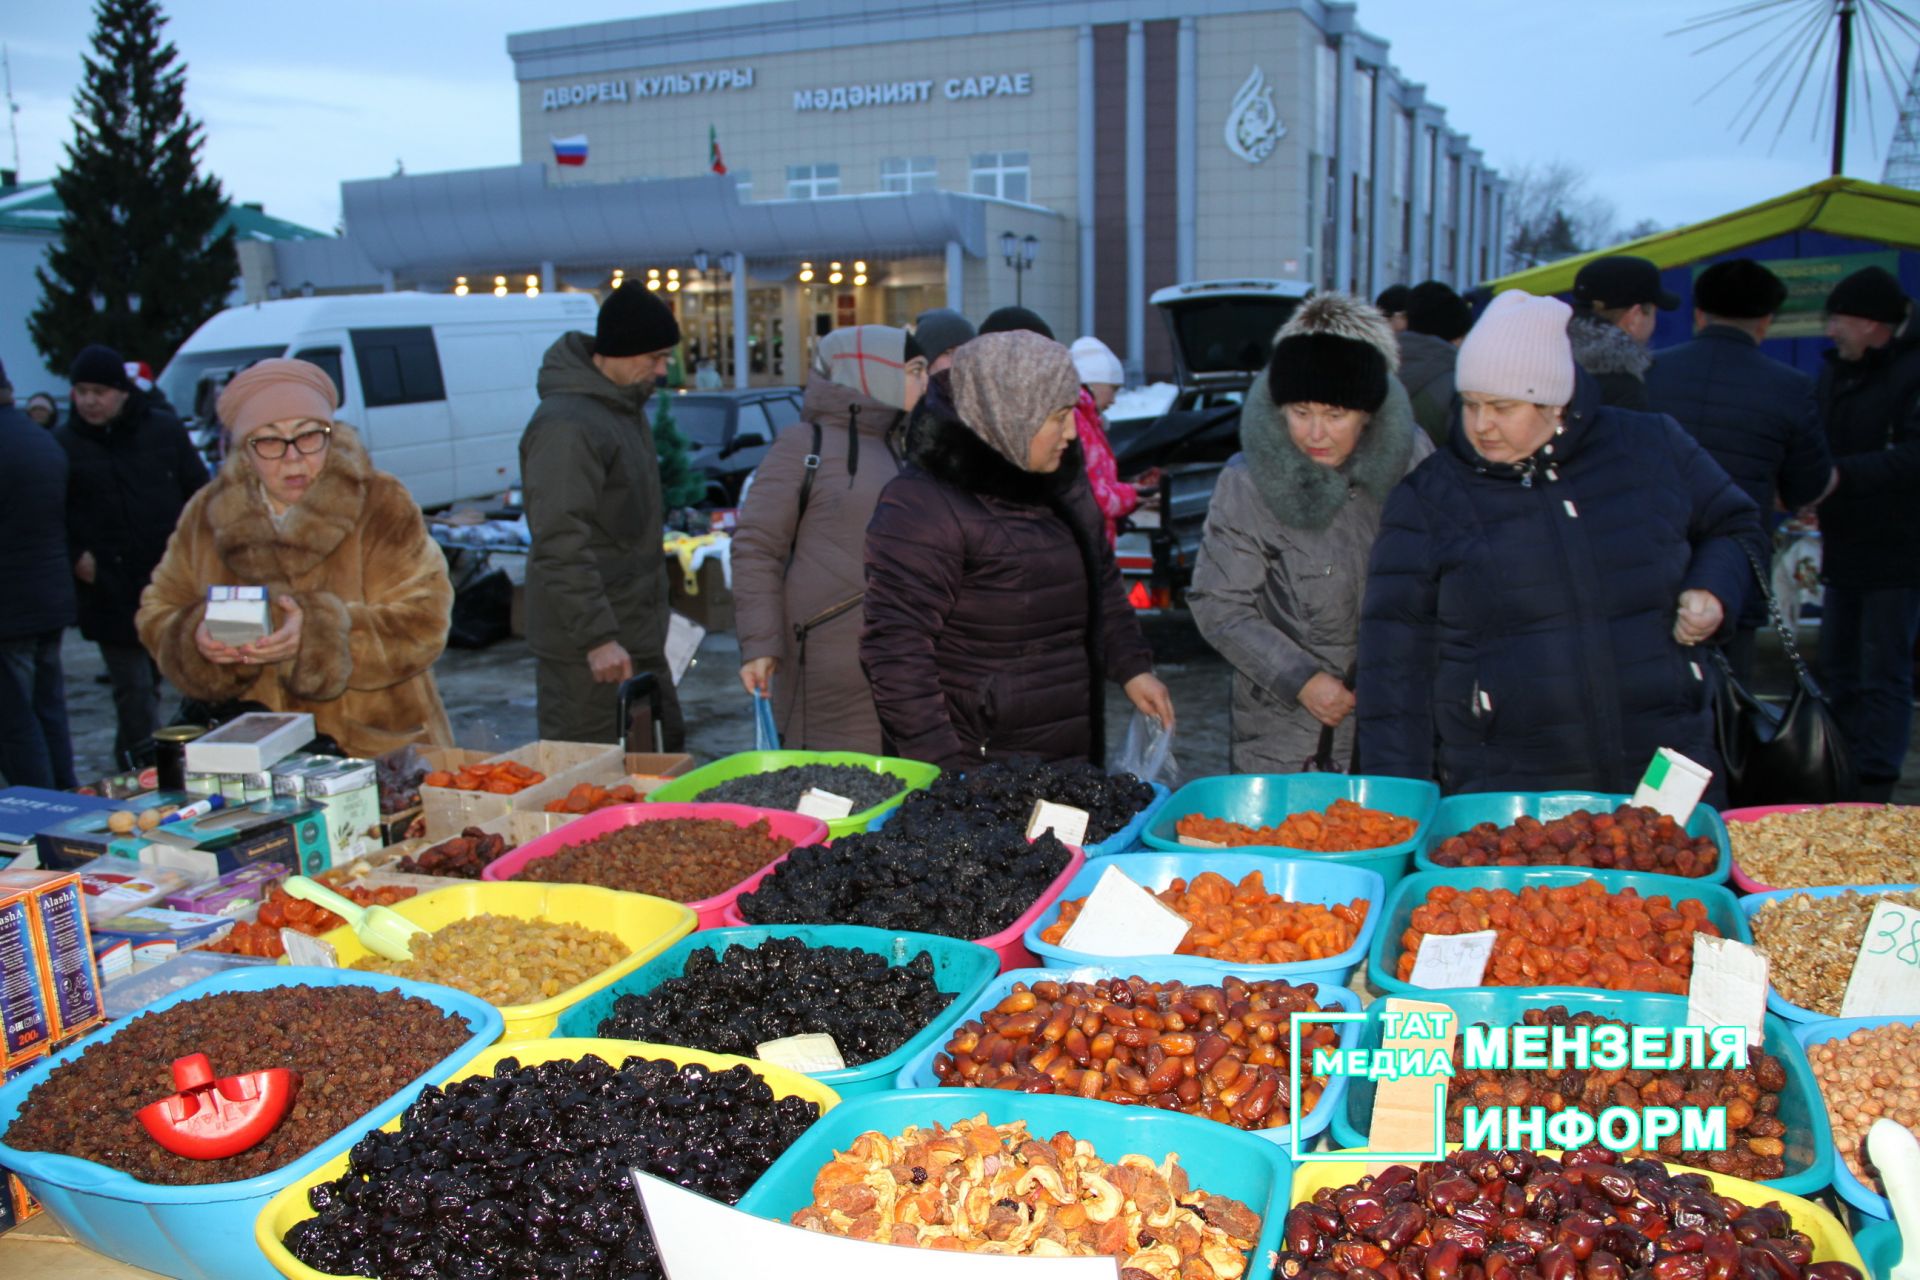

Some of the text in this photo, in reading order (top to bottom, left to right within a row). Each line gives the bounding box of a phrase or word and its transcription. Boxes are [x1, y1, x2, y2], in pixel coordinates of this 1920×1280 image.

[542, 68, 754, 111] ДВОРЕЦ КУЛЬТУРЫ
[793, 73, 1031, 111] МӘДӘНИЯТ САРАЕ
[43, 890, 76, 910] AlashA
[1868, 911, 1920, 968] 38
